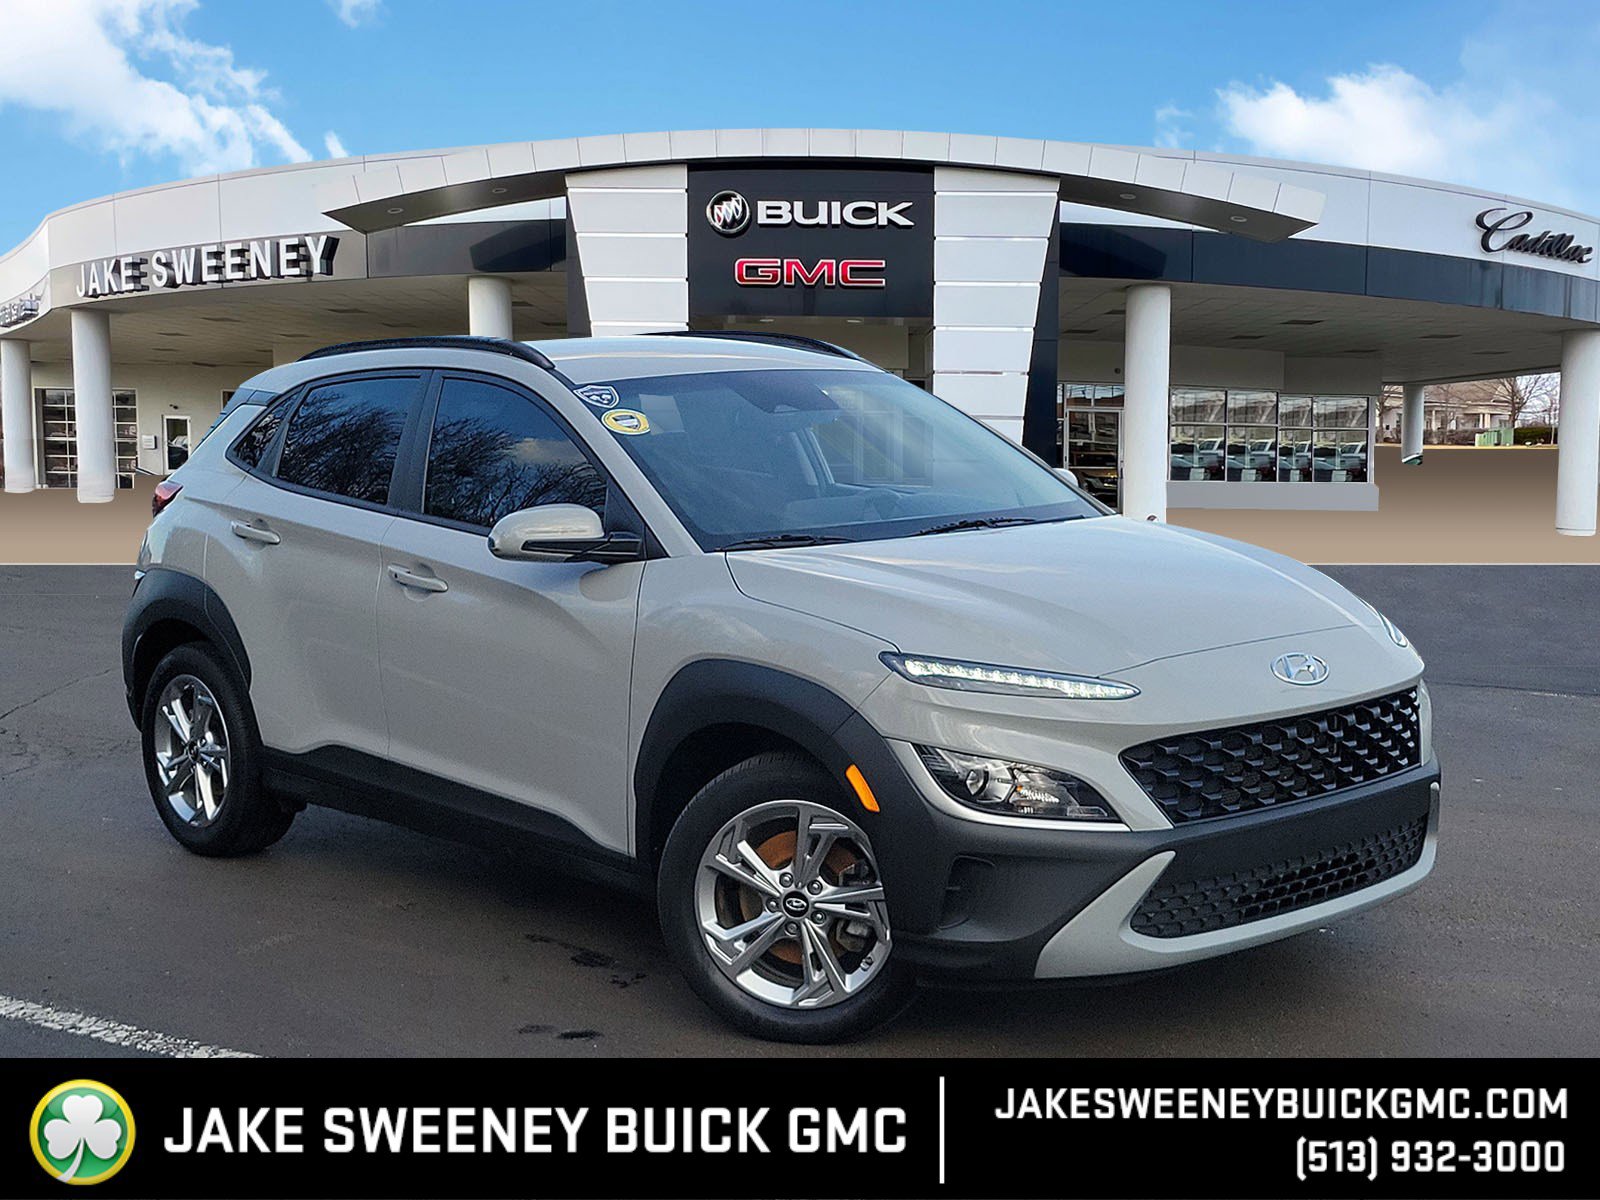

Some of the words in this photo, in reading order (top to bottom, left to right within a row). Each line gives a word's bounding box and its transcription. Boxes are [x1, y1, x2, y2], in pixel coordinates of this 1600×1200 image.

[757, 200, 915, 226] BUICK
[1475, 207, 1594, 264] Cadillac
[76, 256, 141, 297] JAKE
[152, 235, 334, 288] SWEENEY
[734, 257, 886, 287] GMC
